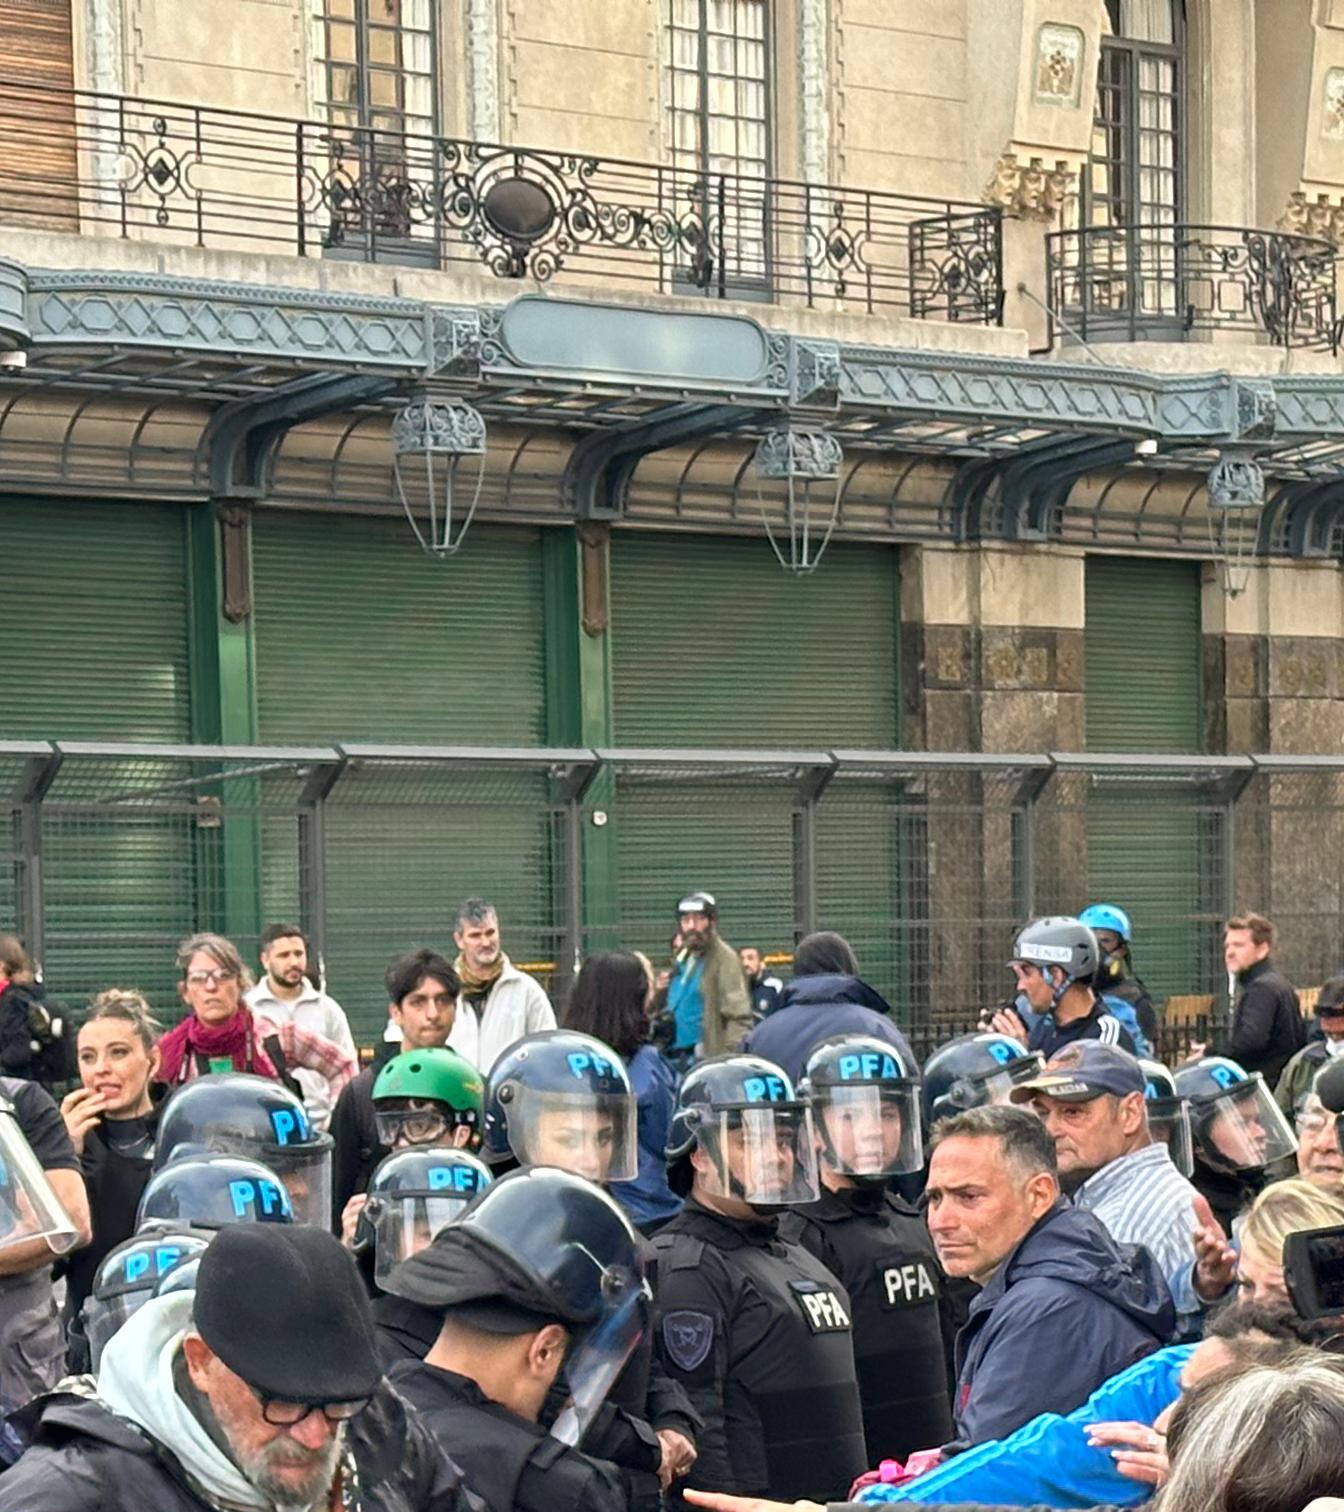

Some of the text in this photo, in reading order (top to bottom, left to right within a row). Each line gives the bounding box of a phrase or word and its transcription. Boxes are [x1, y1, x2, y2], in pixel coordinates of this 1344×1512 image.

[839, 1054, 897, 1081] PFA
[743, 1076, 786, 1103] PF
[125, 1247, 181, 1283] PF
[884, 1263, 936, 1305] PFA
[802, 1291, 850, 1328] PFA
